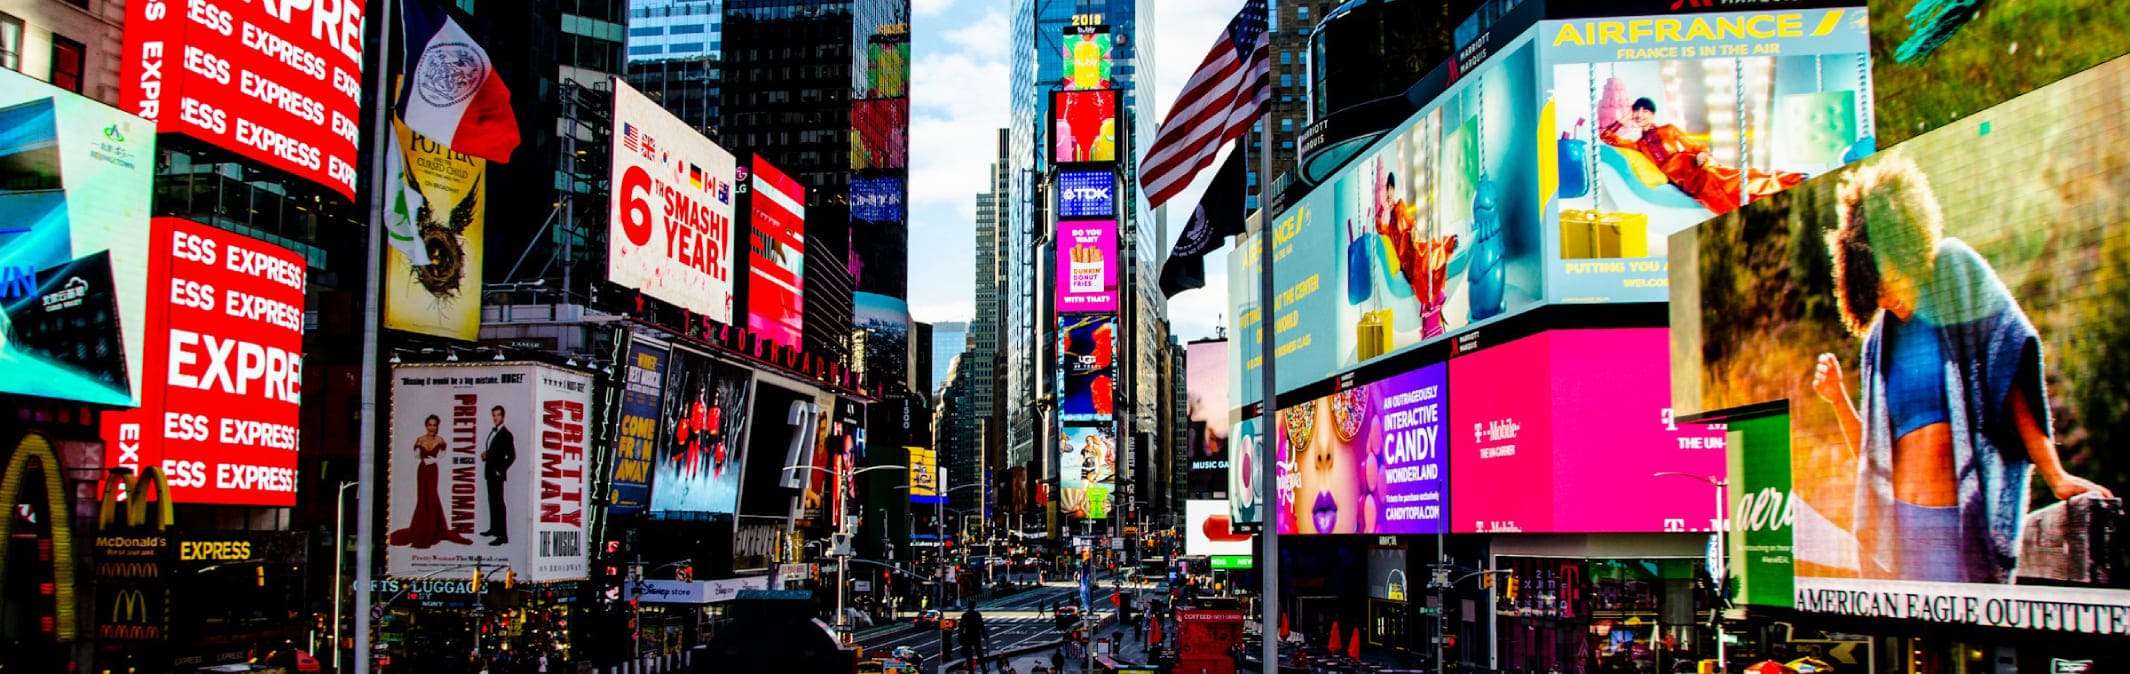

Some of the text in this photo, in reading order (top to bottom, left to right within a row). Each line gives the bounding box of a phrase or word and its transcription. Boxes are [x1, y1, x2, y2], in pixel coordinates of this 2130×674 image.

[187, 0, 233, 36] ESS
[241, 21, 326, 81] EXPRESS
[1460, 32, 1490, 61] MARRIOTT
[1617, 43, 1780, 60] FRANCE IS IN THE AIR
[1460, 48, 1487, 75] MARQUIS
[240, 69, 325, 126] EXPRESS
[235, 117, 321, 171] EXPRESS
[417, 157, 445, 172] CURSED
[446, 166, 468, 179] CHILD
[655, 178, 664, 198] TH
[1074, 188, 1109, 199] TDK
[664, 185, 720, 241] SMASH
[226, 245, 302, 290] EXPRESS
[1566, 261, 1660, 273] PUTTING YOU
[225, 289, 300, 332] EXPRESS
[1384, 384, 1438, 409] AN OUTRAGEOUSLY
[453, 394, 478, 454] PRETTY
[621, 414, 656, 440] COME
[1384, 403, 1438, 431] INTERACTIVE
[220, 418, 295, 451] EXPRESS
[1384, 425, 1438, 464] CANDY
[1677, 437, 1703, 448] THE
[540, 400, 564, 523] WOMAN
[560, 400, 584, 528] PRETTY
[614, 459, 650, 484] AWAY
[1193, 461, 1217, 469] MUSIC
[1386, 463, 1438, 484] WONDERLAND
[217, 463, 292, 493] EXPRESS
[451, 466, 476, 534] WOMAN
[1386, 505, 1440, 520] CANDYTOPIA.COM
[96, 537, 166, 547] McDonald's
[180, 541, 251, 560] EXPRESS
[540, 531, 581, 557] THE MUSICAL
[672, 588, 691, 596] store
[1797, 589, 2130, 635] AMERICAN EAGLE OUTFITTE
